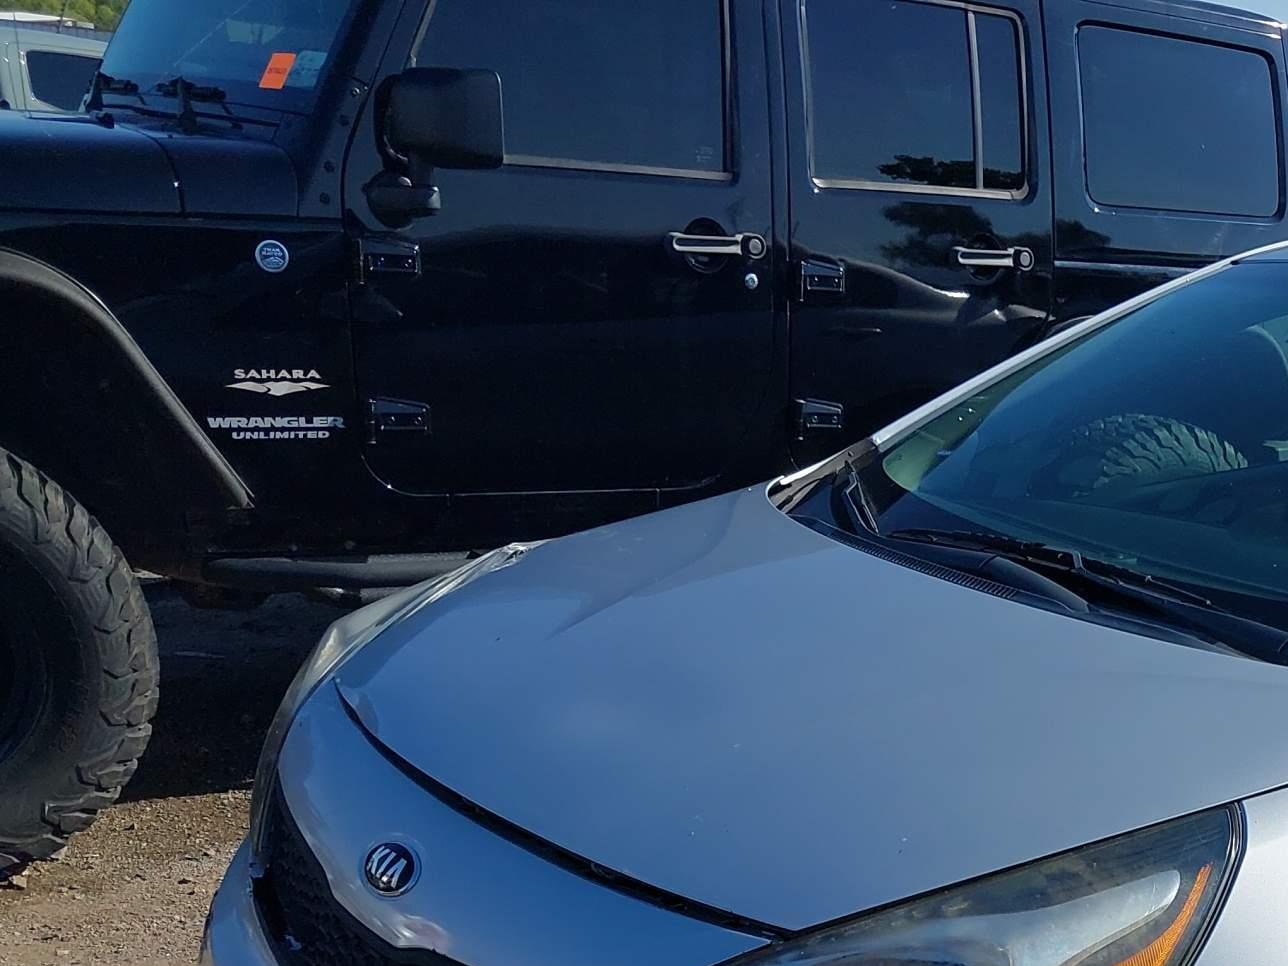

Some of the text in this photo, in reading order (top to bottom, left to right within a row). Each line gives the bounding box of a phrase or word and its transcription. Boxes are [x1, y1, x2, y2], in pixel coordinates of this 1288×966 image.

[234, 369, 322, 379] SAHARA
[207, 416, 346, 429] WRANGLER
[231, 430, 330, 440] UNLIMITED
[366, 845, 407, 889] KIA
